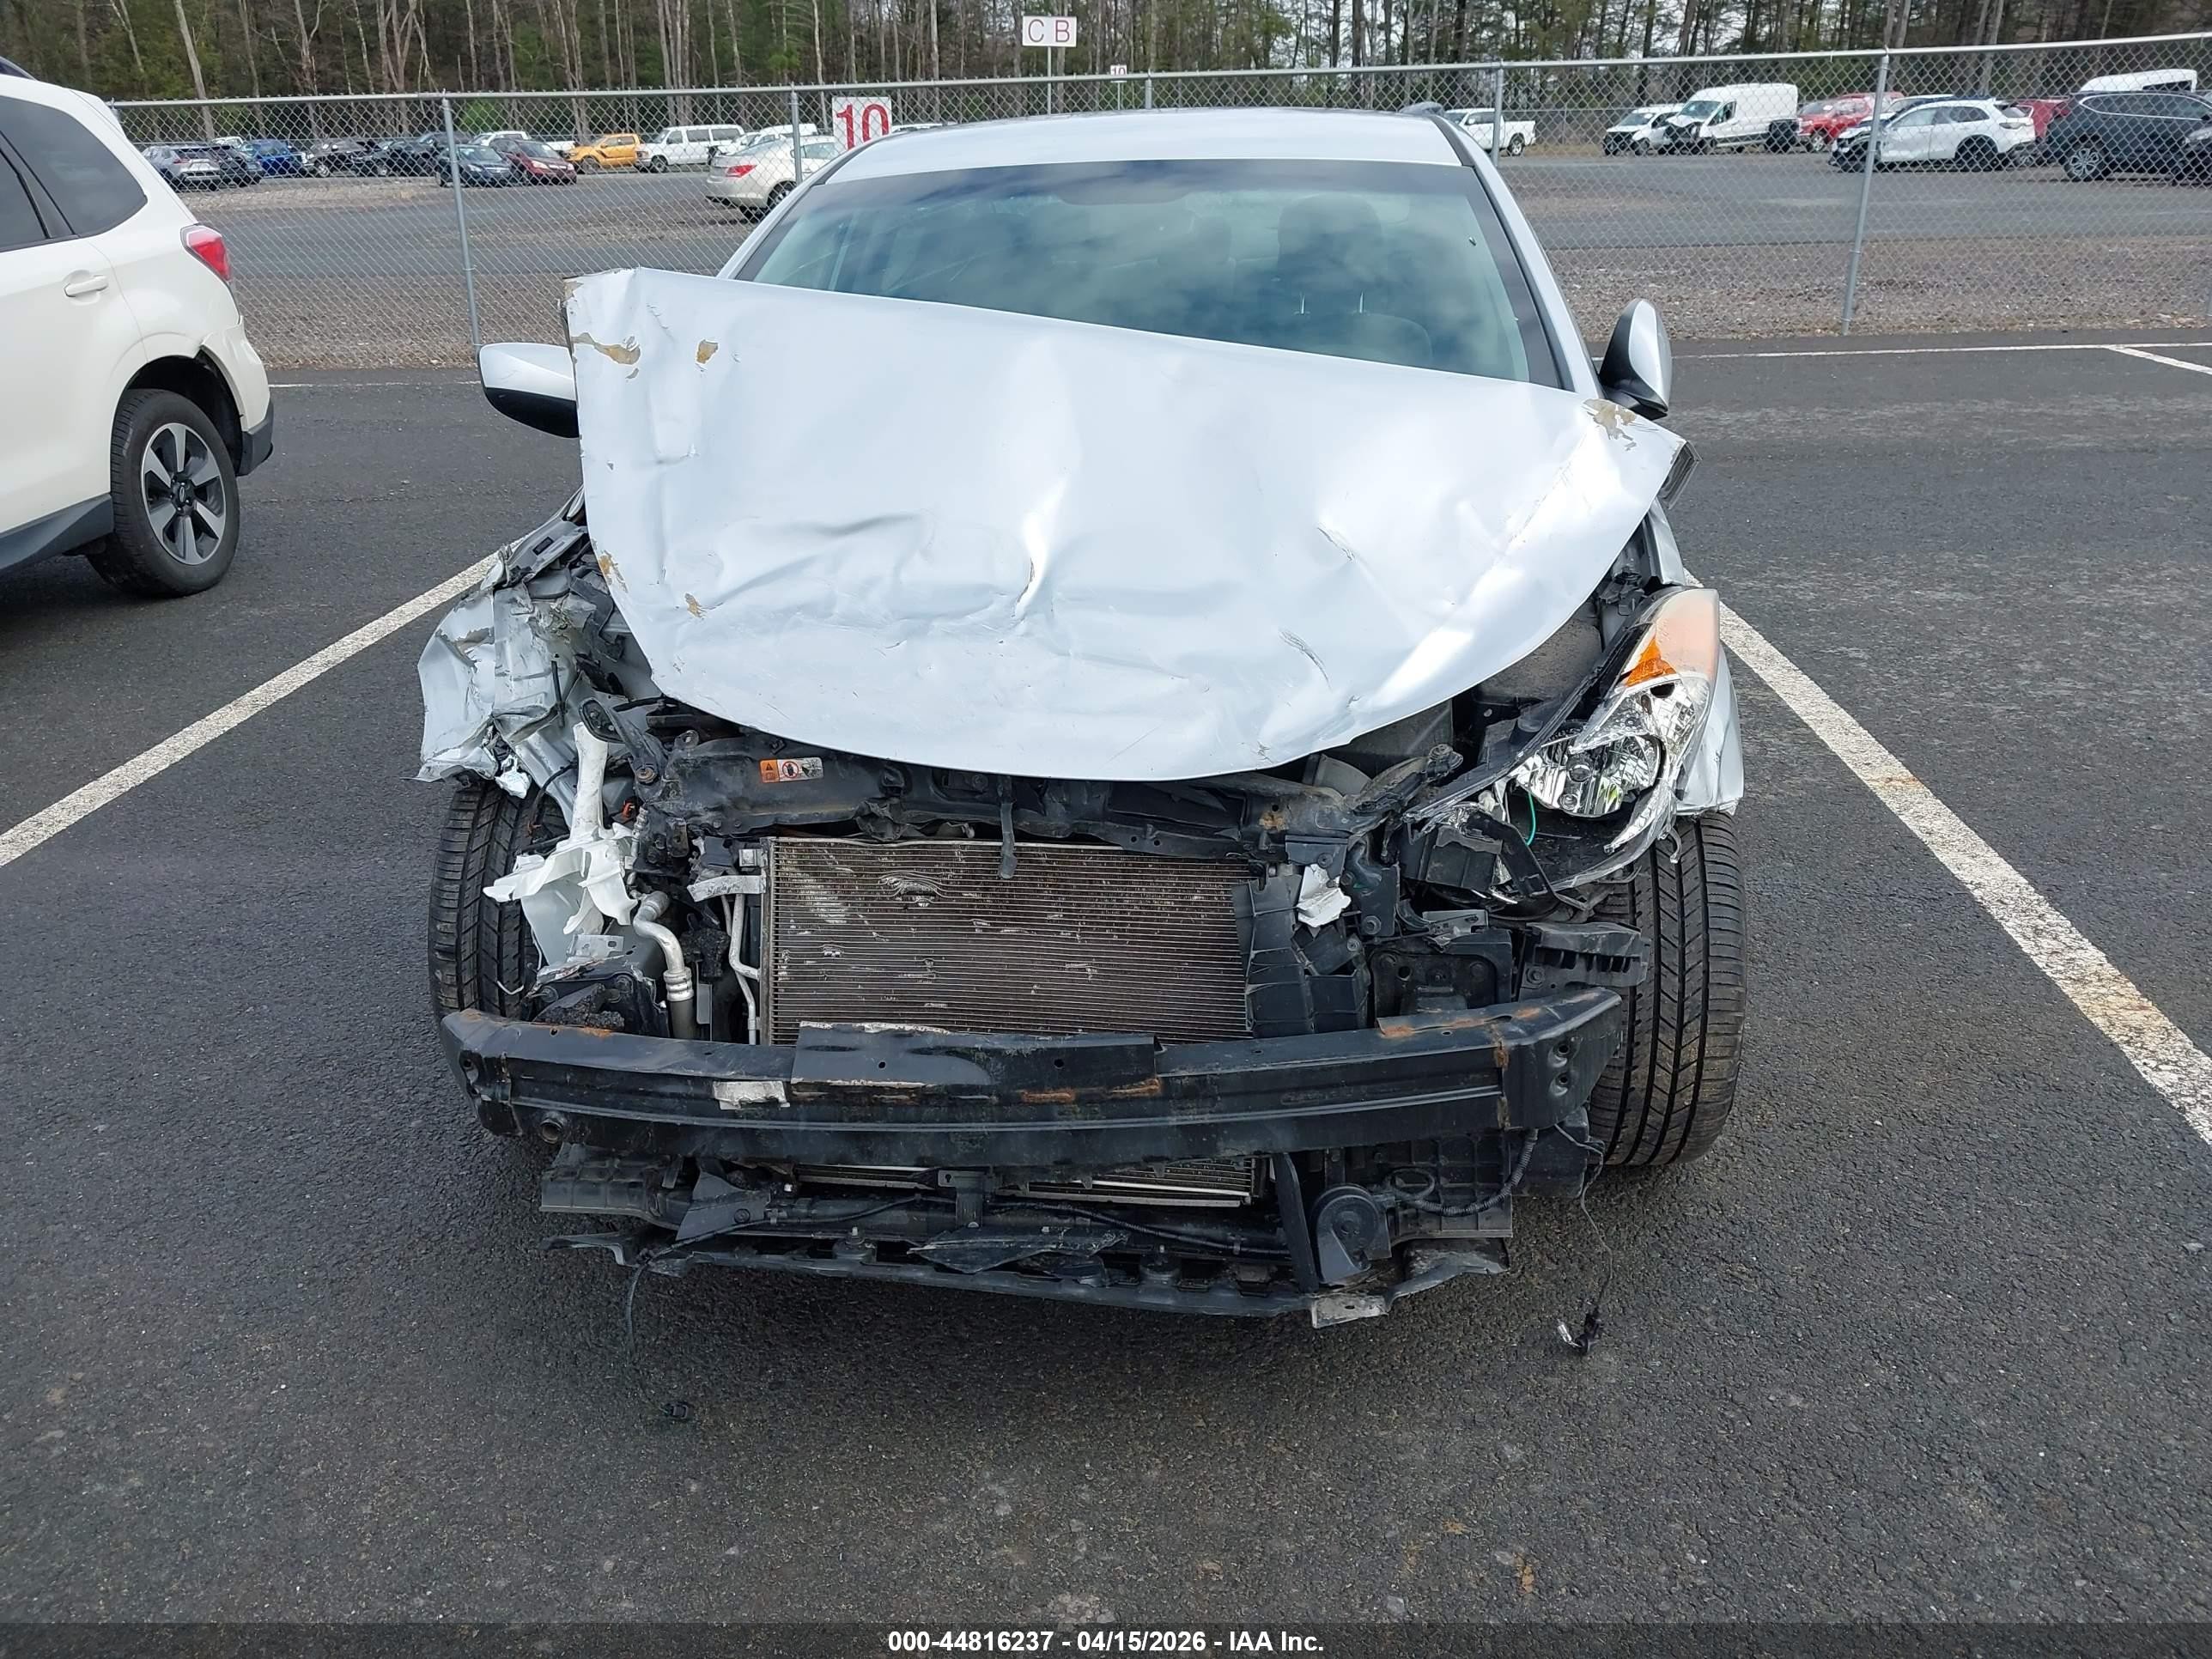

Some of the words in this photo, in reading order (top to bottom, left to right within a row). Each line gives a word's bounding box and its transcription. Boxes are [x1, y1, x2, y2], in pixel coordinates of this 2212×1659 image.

[1028, 19, 1045, 43] C
[1055, 20, 1071, 43] B
[836, 103, 890, 149] 10
